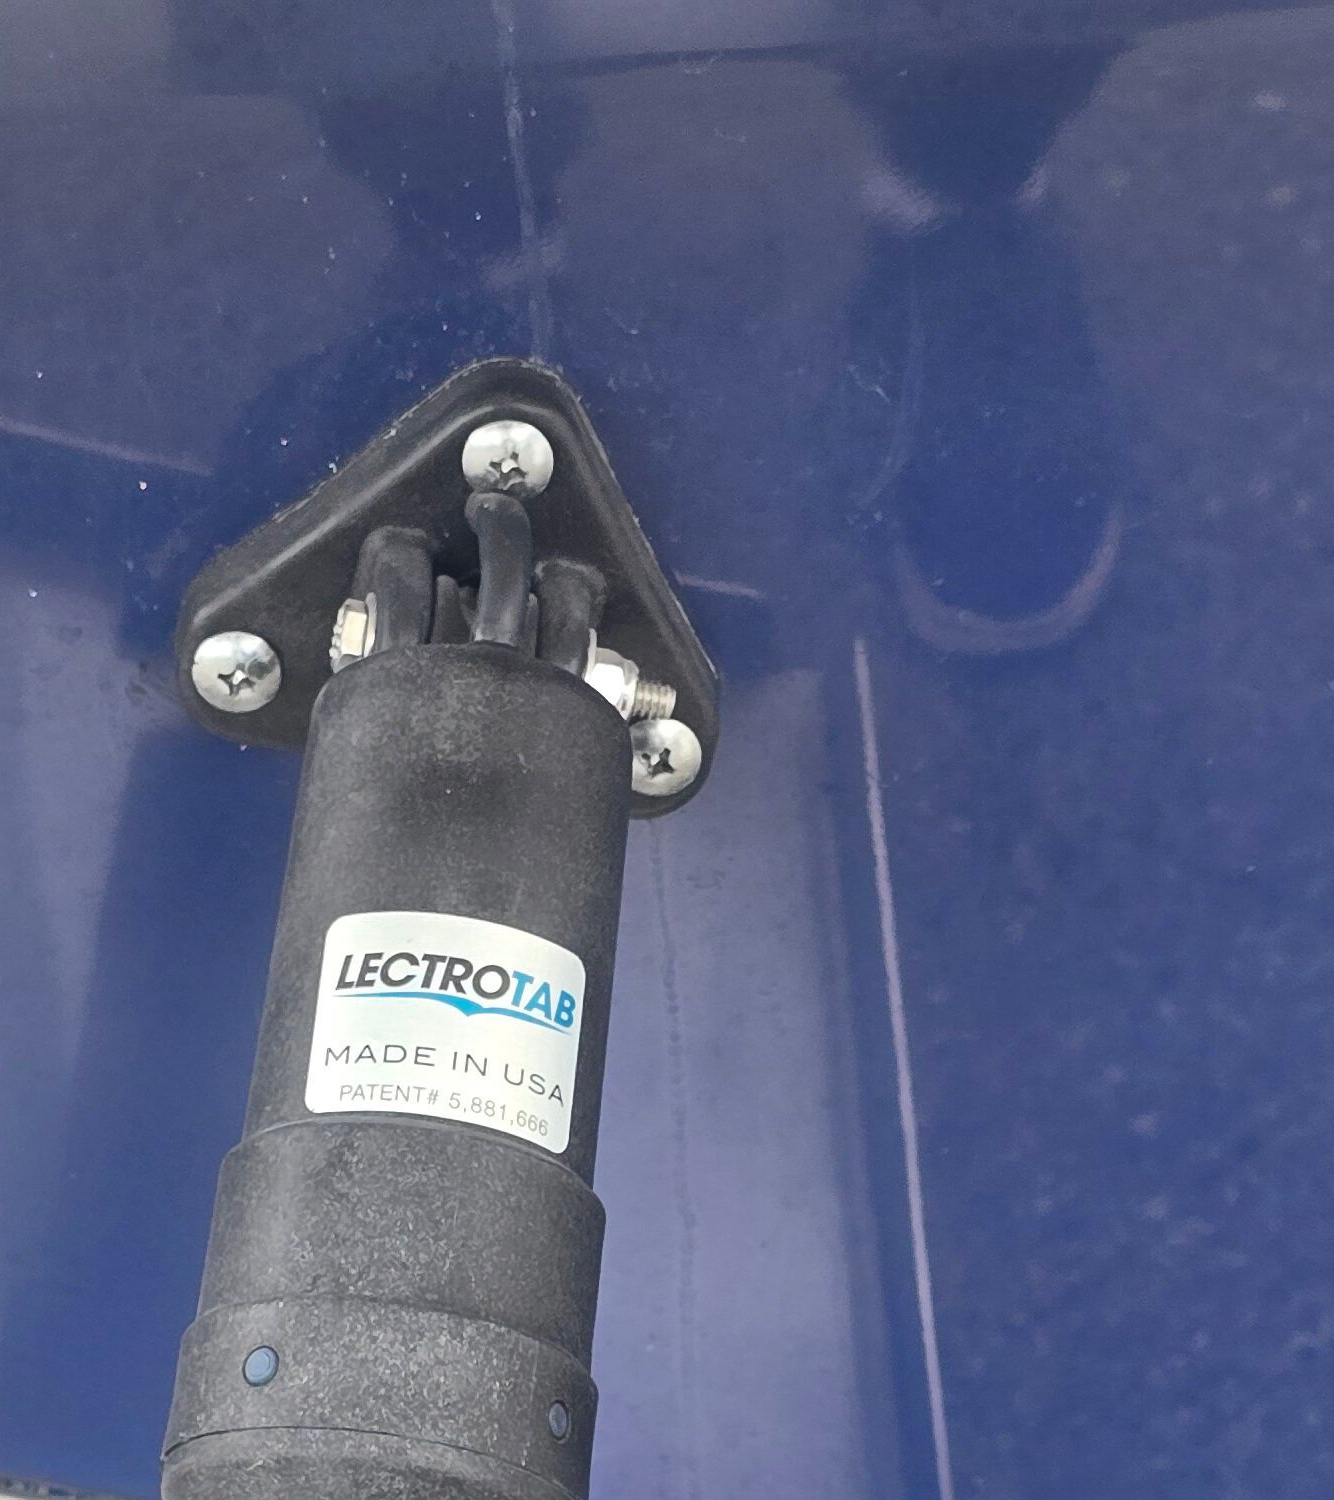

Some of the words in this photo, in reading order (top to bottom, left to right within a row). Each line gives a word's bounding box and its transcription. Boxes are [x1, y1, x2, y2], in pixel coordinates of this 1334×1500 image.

[334, 951, 577, 1029] LECTROTAB
[324, 1044, 437, 1068] MADE
[452, 1051, 488, 1077] IN
[503, 1063, 565, 1107] USA
[338, 1083, 439, 1106] PATENT#
[448, 1091, 550, 1138] 5,881,666
